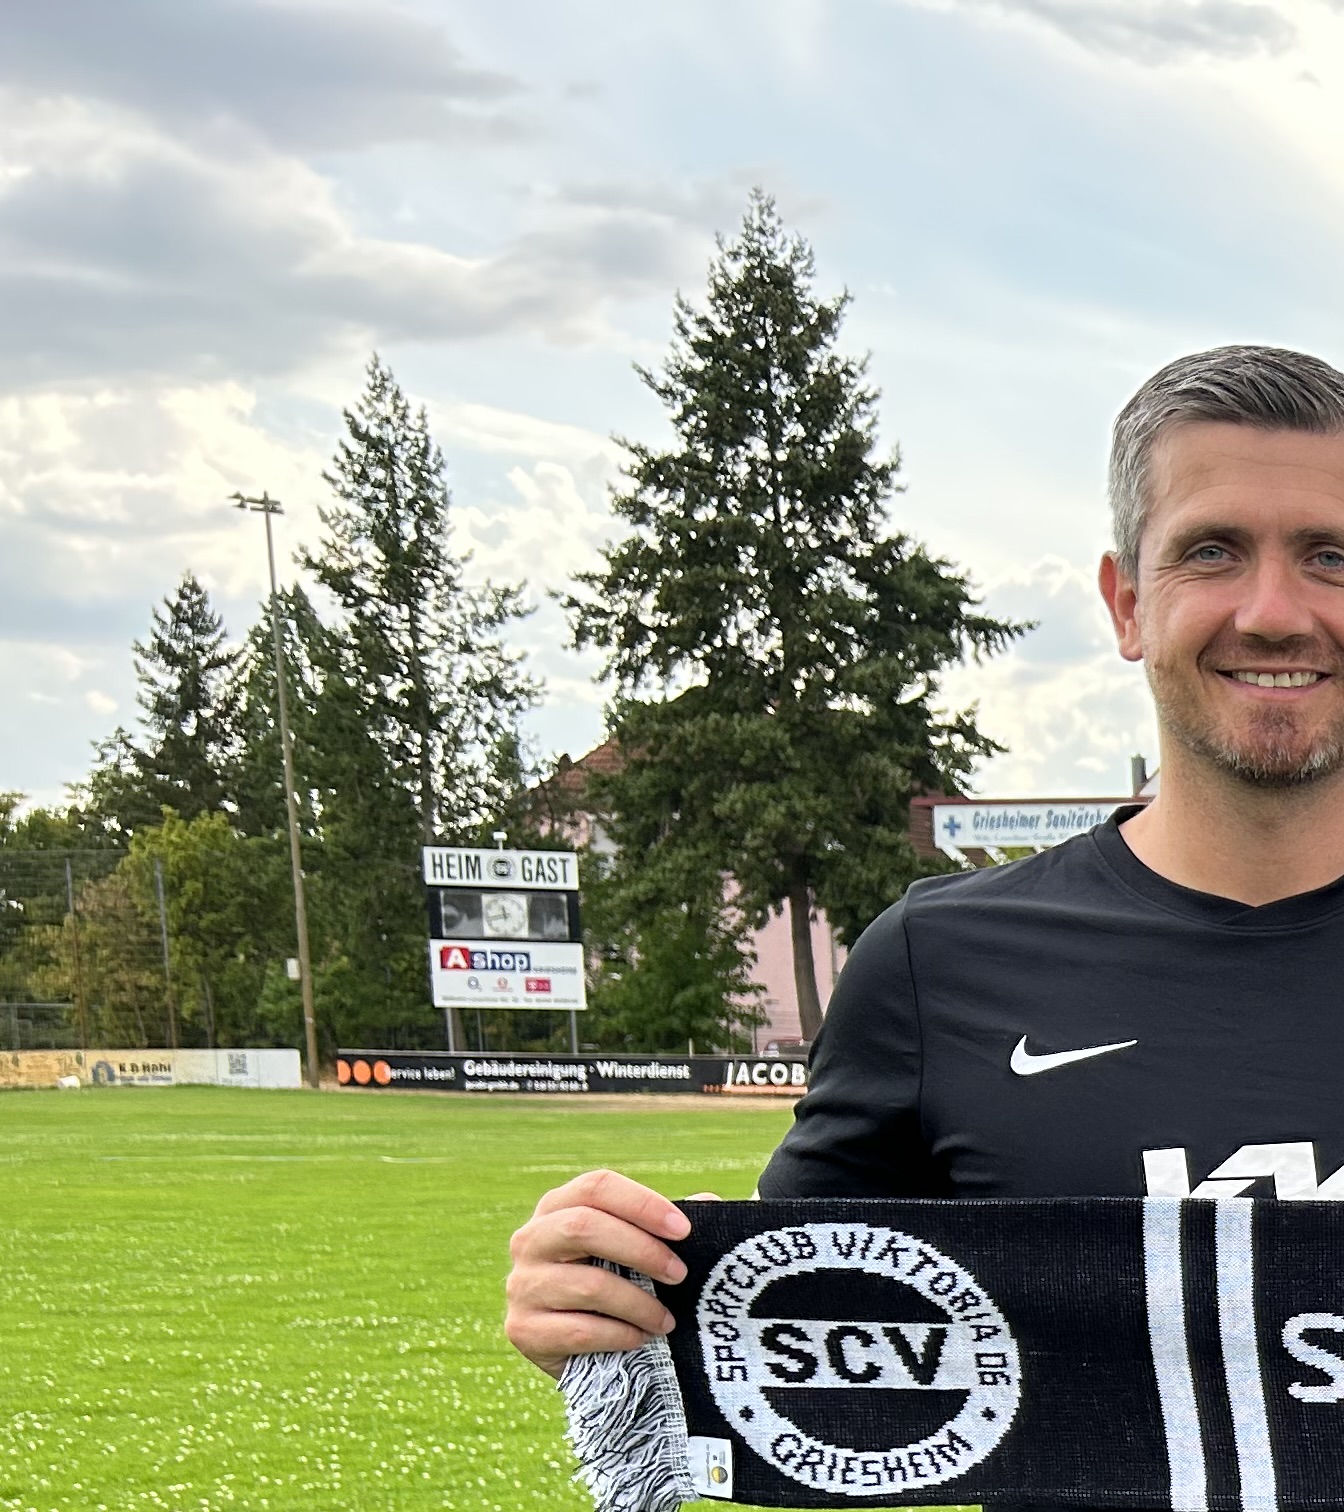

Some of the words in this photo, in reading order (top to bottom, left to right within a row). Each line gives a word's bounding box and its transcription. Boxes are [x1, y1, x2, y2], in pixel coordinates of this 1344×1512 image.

[973, 809, 1041, 830] Griesheimer
[1045, 806, 1108, 830] Sanitätsh
[431, 853, 482, 881] HEIM
[521, 856, 570, 884] GAST
[463, 1059, 588, 1081] Gebäudereinigung
[596, 1060, 691, 1080] Winterdienst
[704, 1230, 818, 1383] SPORTCLUB
[831, 1230, 1002, 1342] VIKTORIA
[758, 1322, 949, 1386] SCV
[770, 1429, 973, 1487] GRIESHEIM
